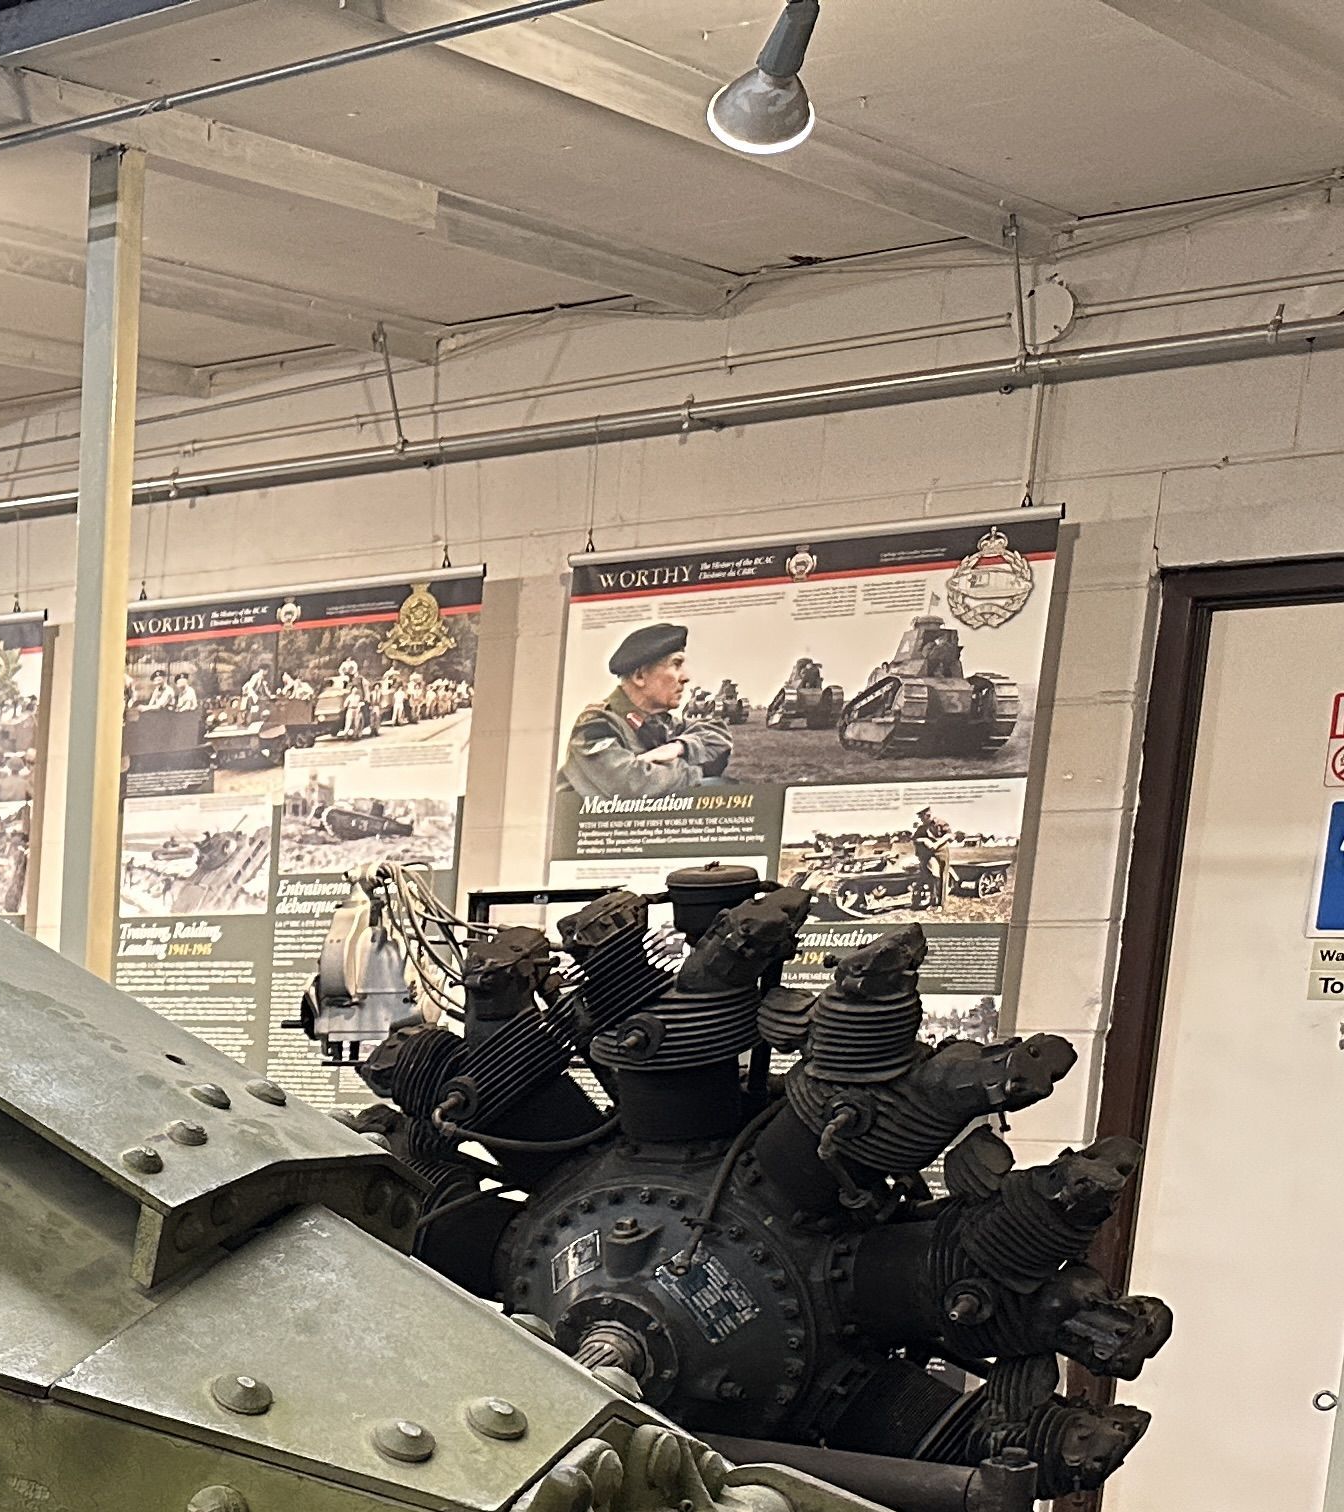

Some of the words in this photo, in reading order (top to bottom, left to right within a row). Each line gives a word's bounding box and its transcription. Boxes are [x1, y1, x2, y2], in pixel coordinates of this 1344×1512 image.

[599, 564, 694, 588] WORTHY
[132, 614, 206, 634] WORTHY
[579, 793, 694, 814] Mechanization
[695, 795, 754, 811] 1919-1941
[119, 922, 172, 942] Training,
[172, 920, 223, 942] Raiding,
[117, 940, 168, 960] Landing
[1319, 978, 1344, 994] To
